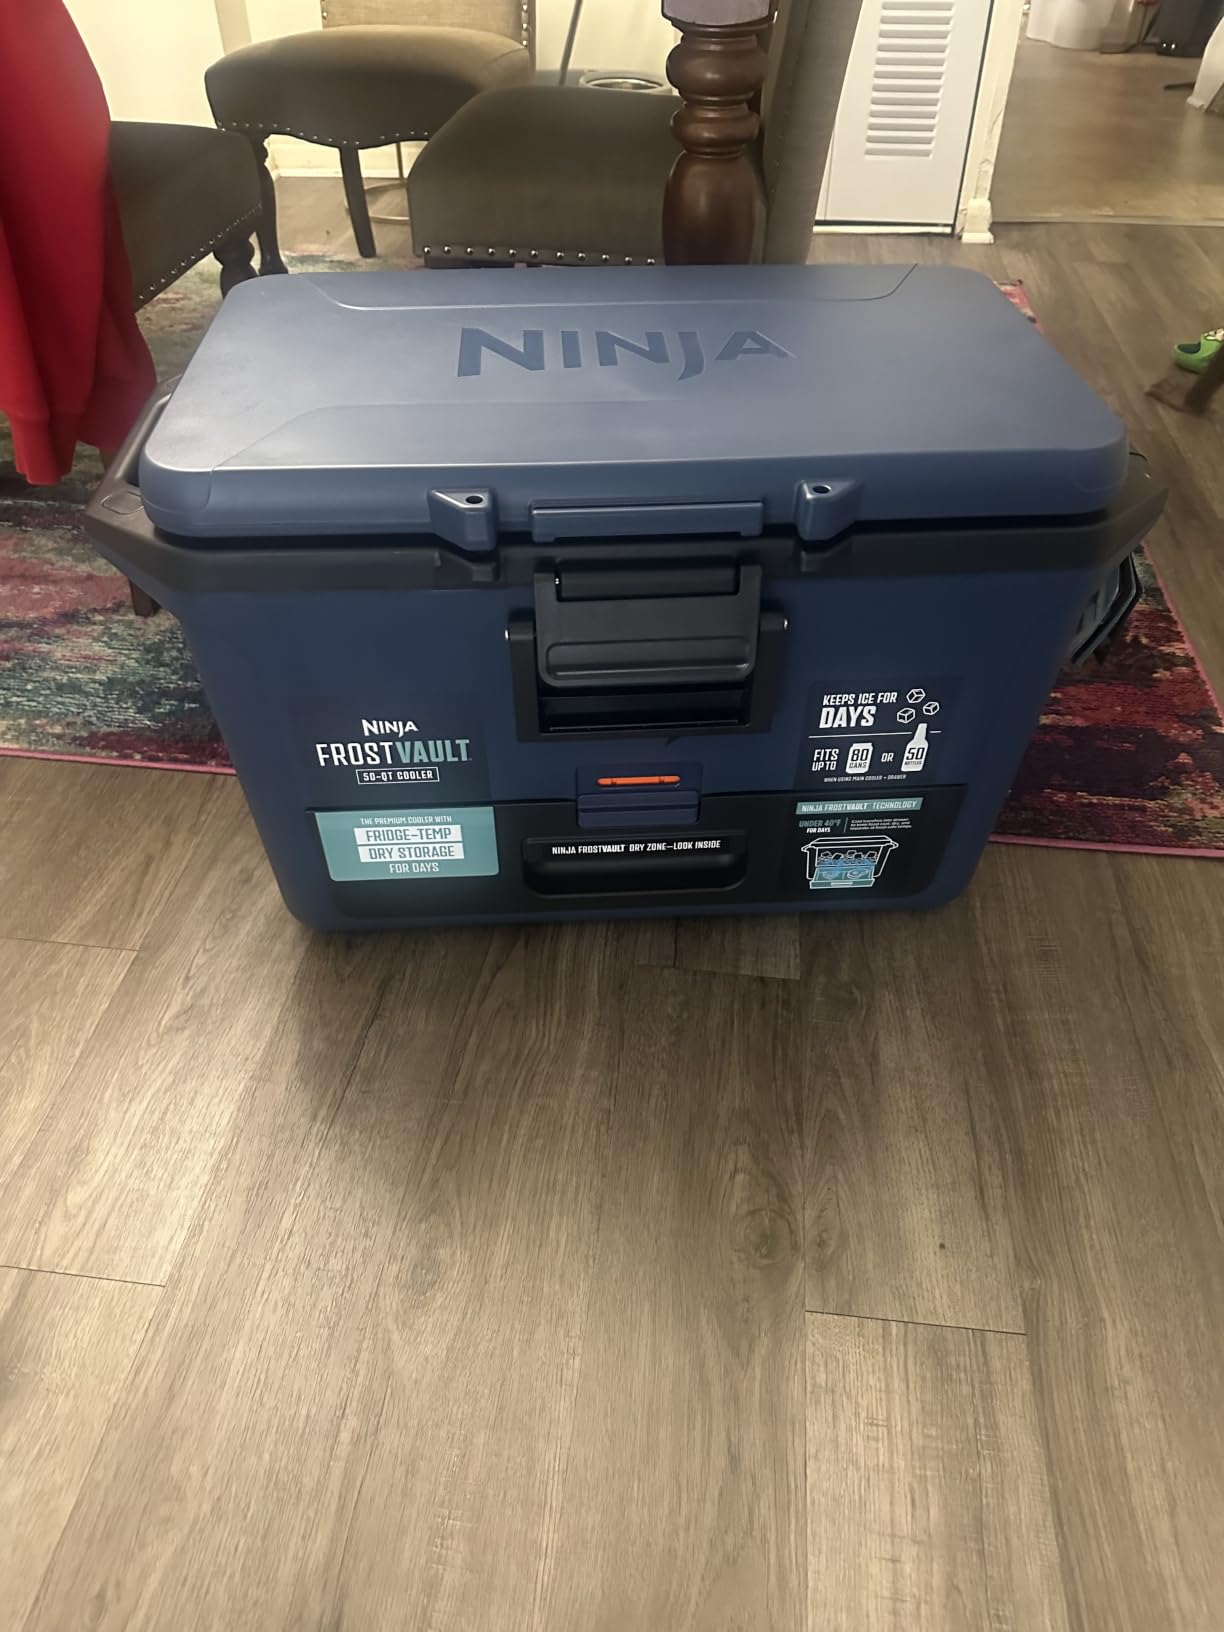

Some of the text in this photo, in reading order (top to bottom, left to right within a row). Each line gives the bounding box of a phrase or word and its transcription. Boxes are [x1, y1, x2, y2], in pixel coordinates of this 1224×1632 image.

[457, 327, 798, 381] NINJA
[822, 692, 898, 706] KEEPS ICE FOR
[819, 706, 876, 729] DAYS
[361, 719, 419, 738] NINJA
[315, 739, 470, 766] FROSTVAULT
[813, 748, 839, 761] FITS
[850, 749, 869, 761] 80
[881, 752, 894, 763] OR
[906, 747, 925, 760] 50
[811, 761, 837, 771] UP TO
[849, 761, 868, 769] CANS
[363, 770, 434, 782] 50-QT COOLER
[801, 804, 823, 812] NINJA
[872, 800, 917, 810] TECHNOLOGY
[374, 817, 406, 825] PREMIUM
[407, 816, 434, 824] COOLER
[434, 815, 452, 823] WITH
[799, 819, 823, 827] UNDER
[365, 827, 452, 842] FRIDGE-TEMP
[368, 845, 455, 860] DRY STORAGE
[552, 846, 576, 855] NINJA
[578, 844, 625, 854] FROSTVAULT
[629, 843, 645, 852] DRY
[695, 840, 721, 849] INSIDE
[389, 862, 439, 873] FOR DAYS
